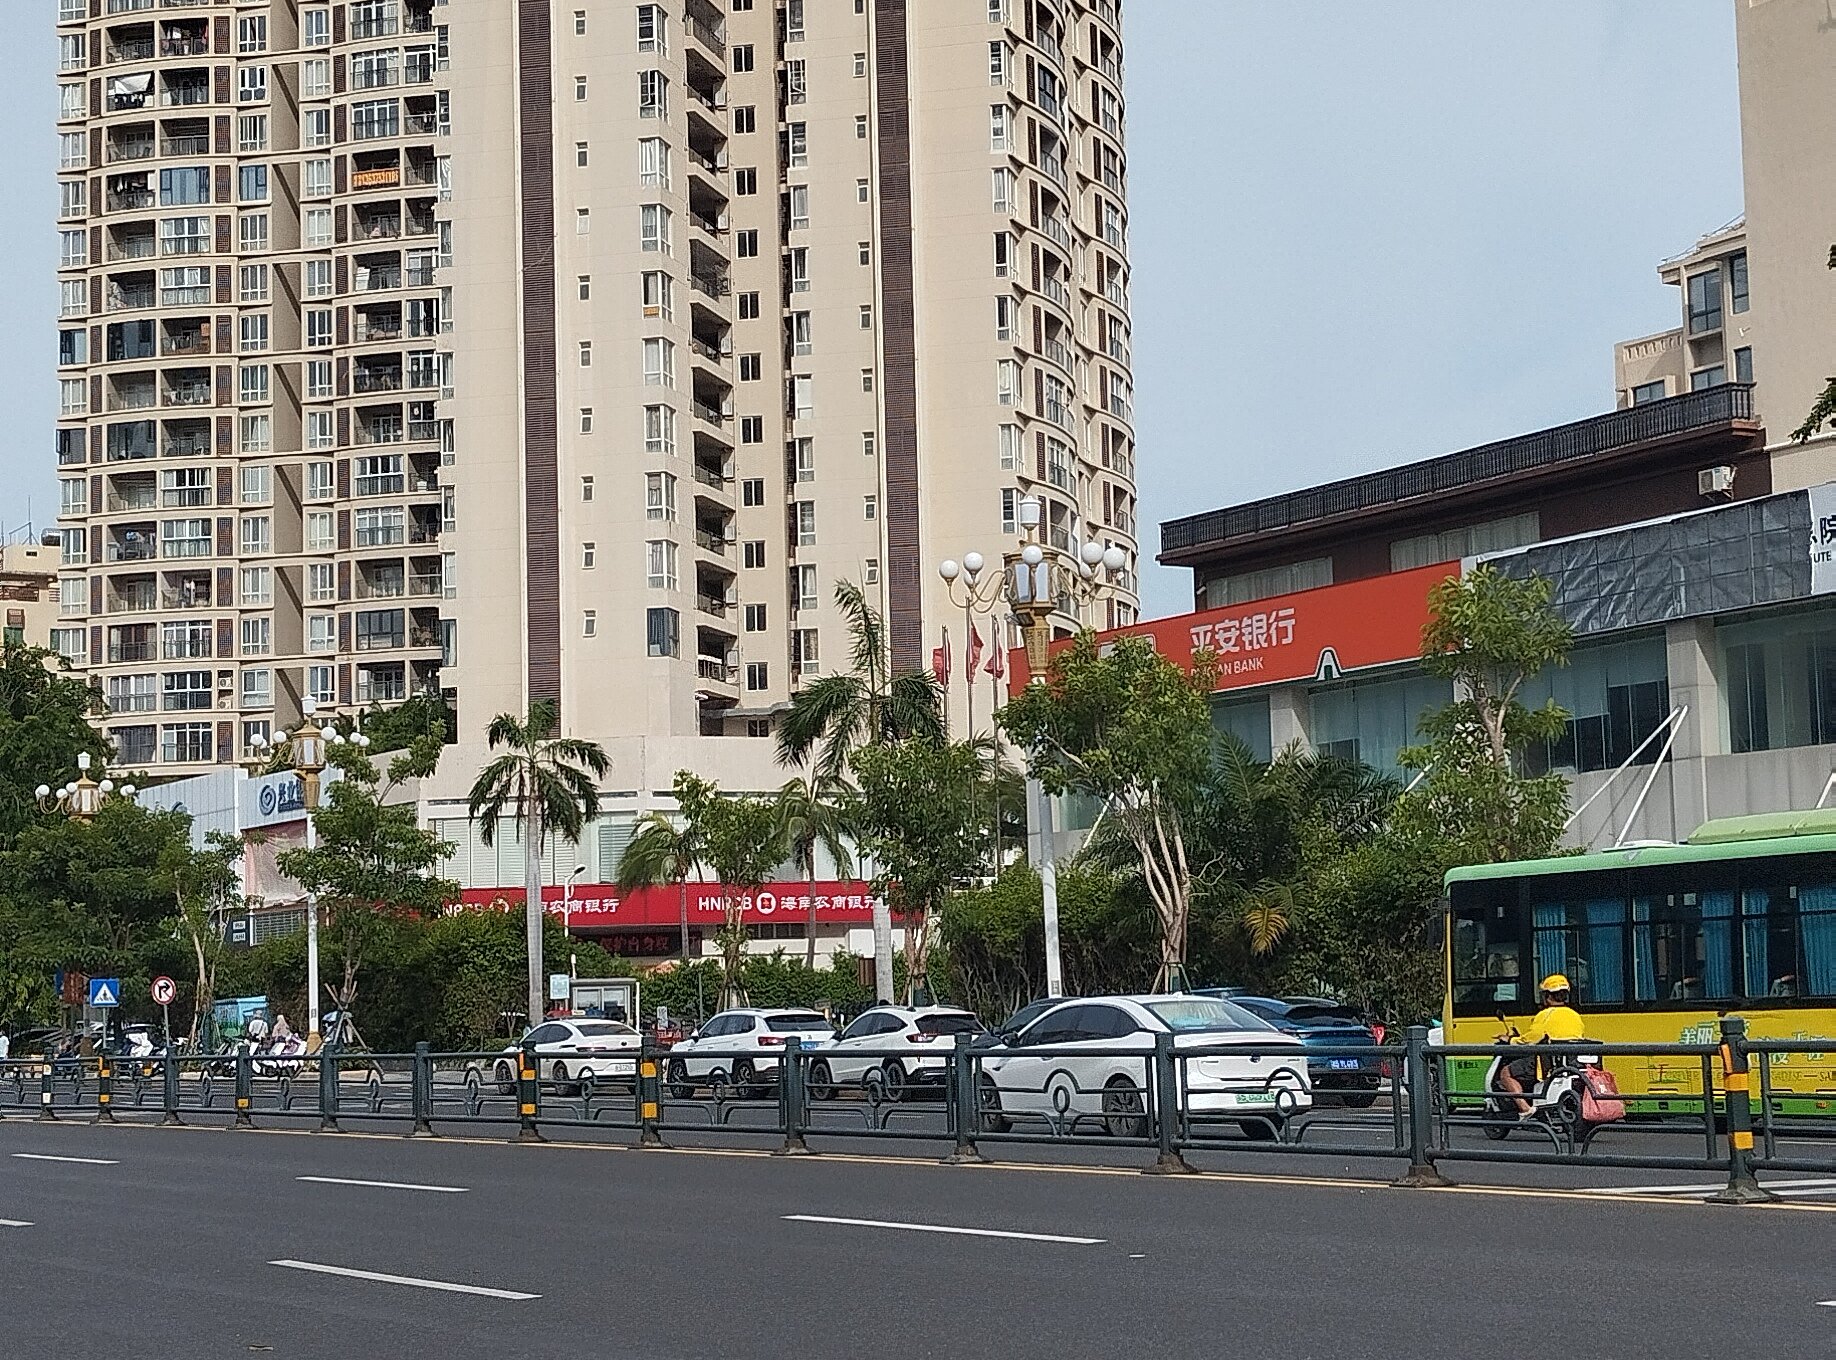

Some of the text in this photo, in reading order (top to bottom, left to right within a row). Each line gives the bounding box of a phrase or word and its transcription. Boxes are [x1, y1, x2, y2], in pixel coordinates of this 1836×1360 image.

[1189, 607, 1296, 656] 平安银行
[1233, 656, 1264, 674] BANK
